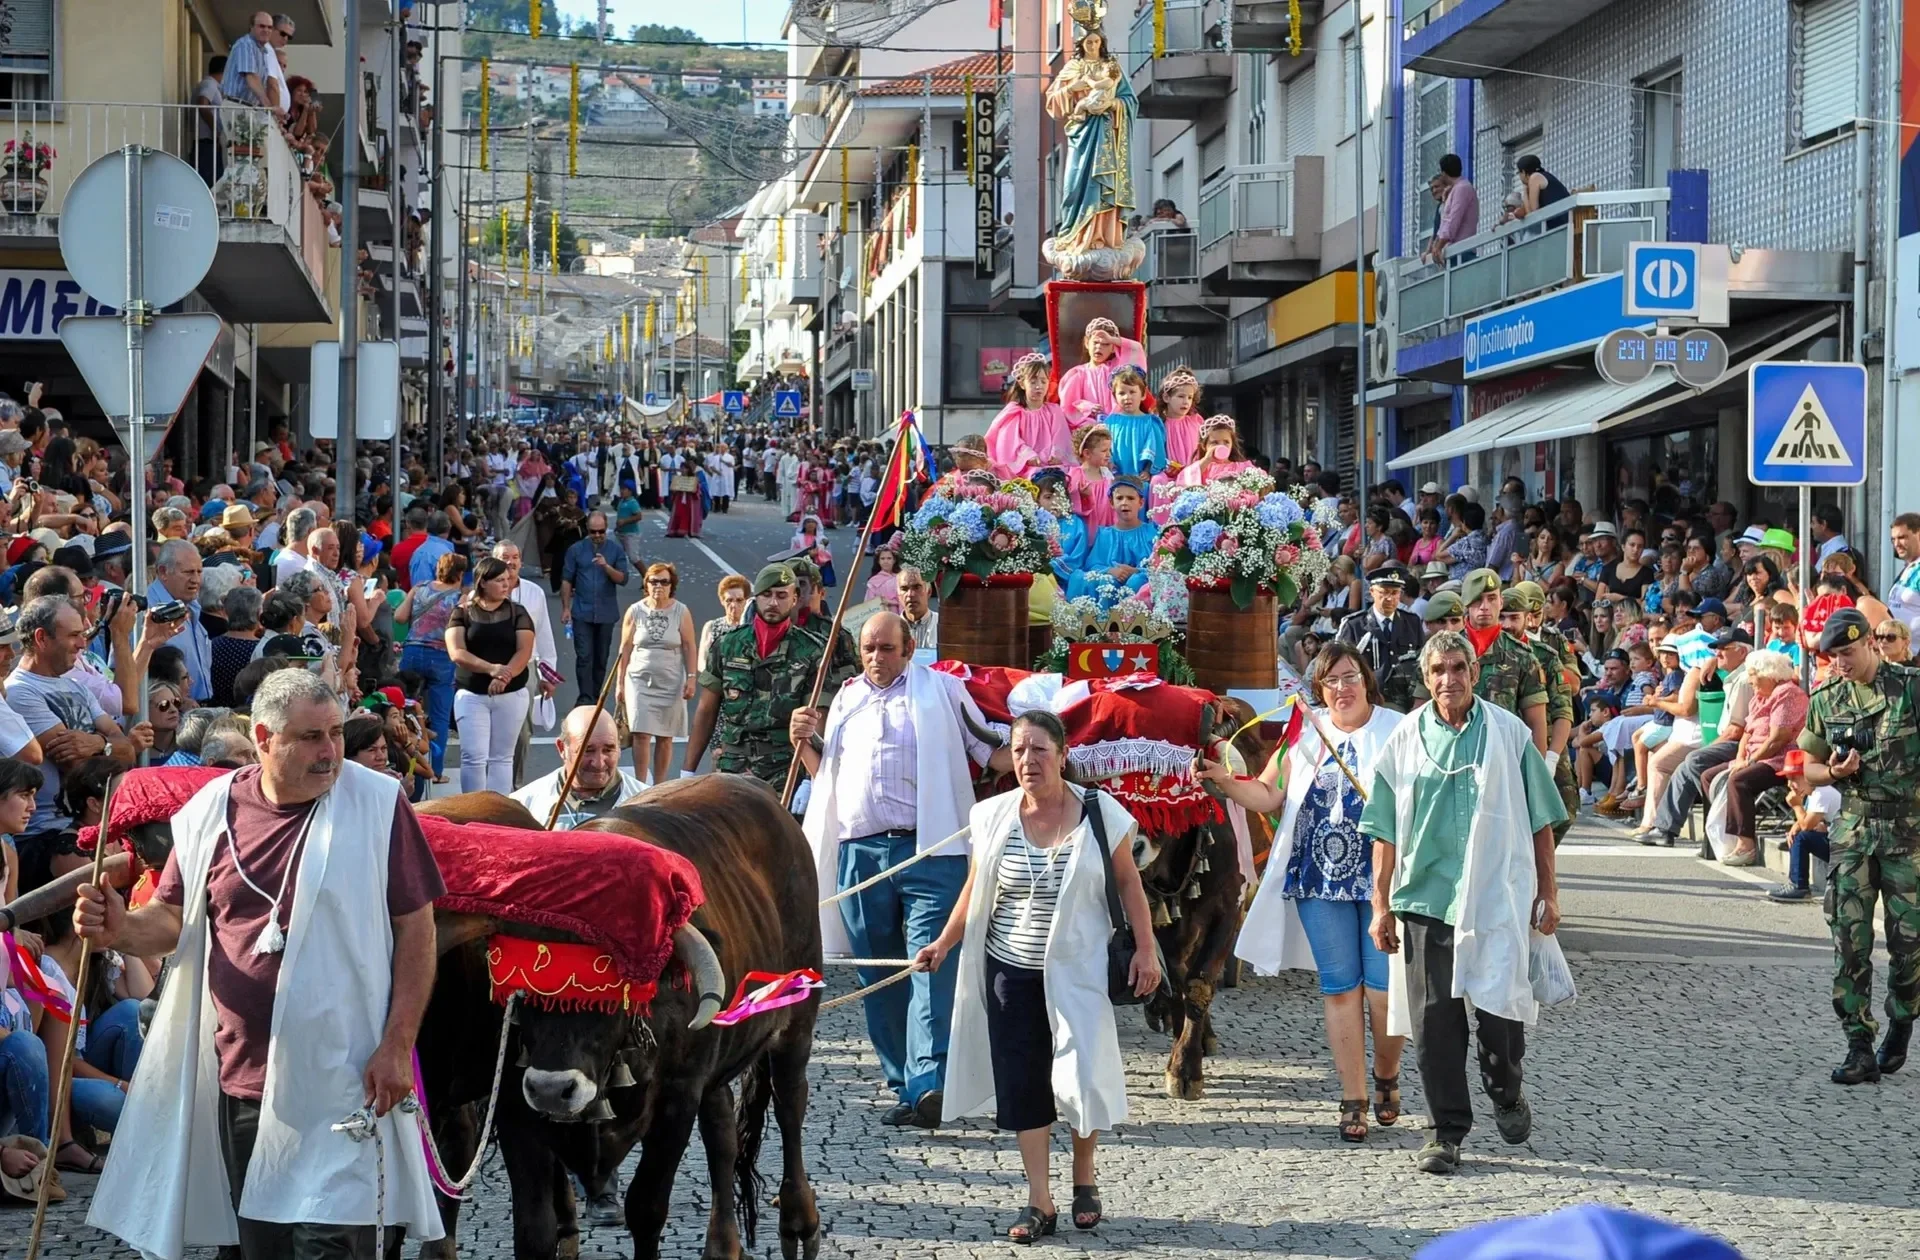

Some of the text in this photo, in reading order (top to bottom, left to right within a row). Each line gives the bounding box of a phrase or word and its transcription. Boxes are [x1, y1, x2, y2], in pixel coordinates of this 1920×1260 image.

[977, 98, 993, 272] COMPRABEM
[1480, 314, 1534, 356] institutoptico
[1618, 339, 1645, 361] 254
[1686, 340, 1709, 362] 517
